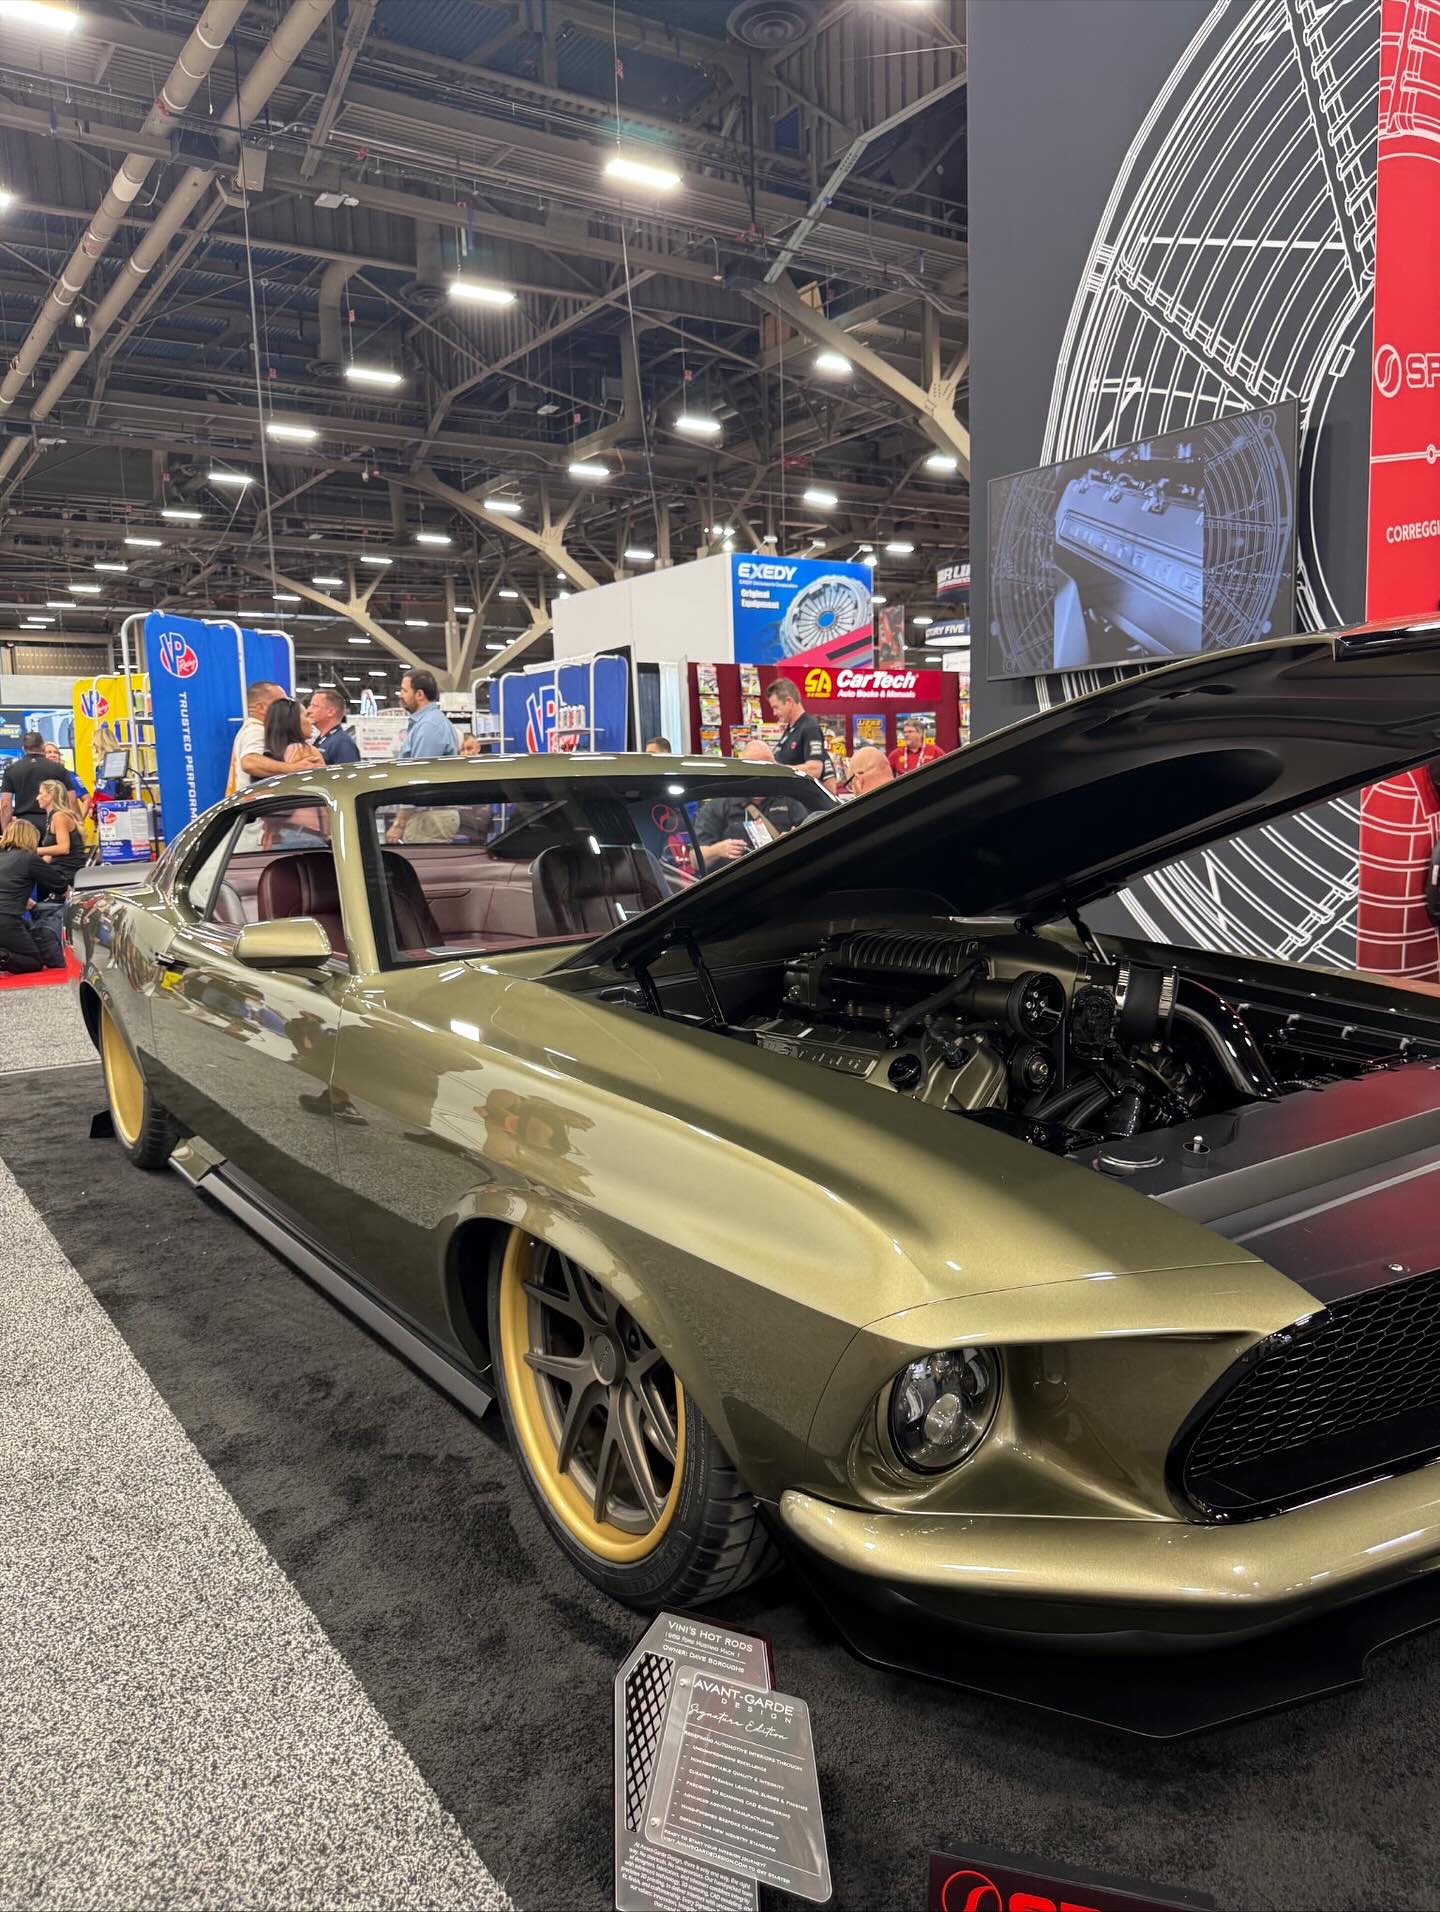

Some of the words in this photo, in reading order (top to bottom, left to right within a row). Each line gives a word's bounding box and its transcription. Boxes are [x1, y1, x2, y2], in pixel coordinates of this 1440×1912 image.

[738, 562, 798, 581] EXEDY
[740, 588, 770, 599] Original
[741, 599, 779, 609] Equipment
[944, 624, 966, 635] FIVE
[836, 669, 916, 689] CarTech
[837, 689, 855, 698] Auto
[856, 689, 879, 698] Books
[886, 690, 916, 698] Manuals
[178, 691, 192, 752] TRUSTED
[669, 1621, 696, 1635] VINI'S
[700, 1630, 721, 1643] HOT
[725, 1638, 752, 1652] RODS
[663, 1645, 687, 1656] OWNER:
[689, 1652, 706, 1661] DAVE
[708, 1658, 744, 1673] BOROUGHS
[694, 1680, 793, 1715] AVANT-GARDE
[721, 1698, 791, 1723] DESIGN
[687, 1703, 743, 1726] Signature
[745, 1721, 787, 1739] Edition
[714, 1741, 747, 1754] AUTOMOTIVE
[776, 1759, 802, 1771] THROUGH
[732, 1770, 753, 1779] QUALITY
[710, 1802, 731, 1811] ADDITIVE
